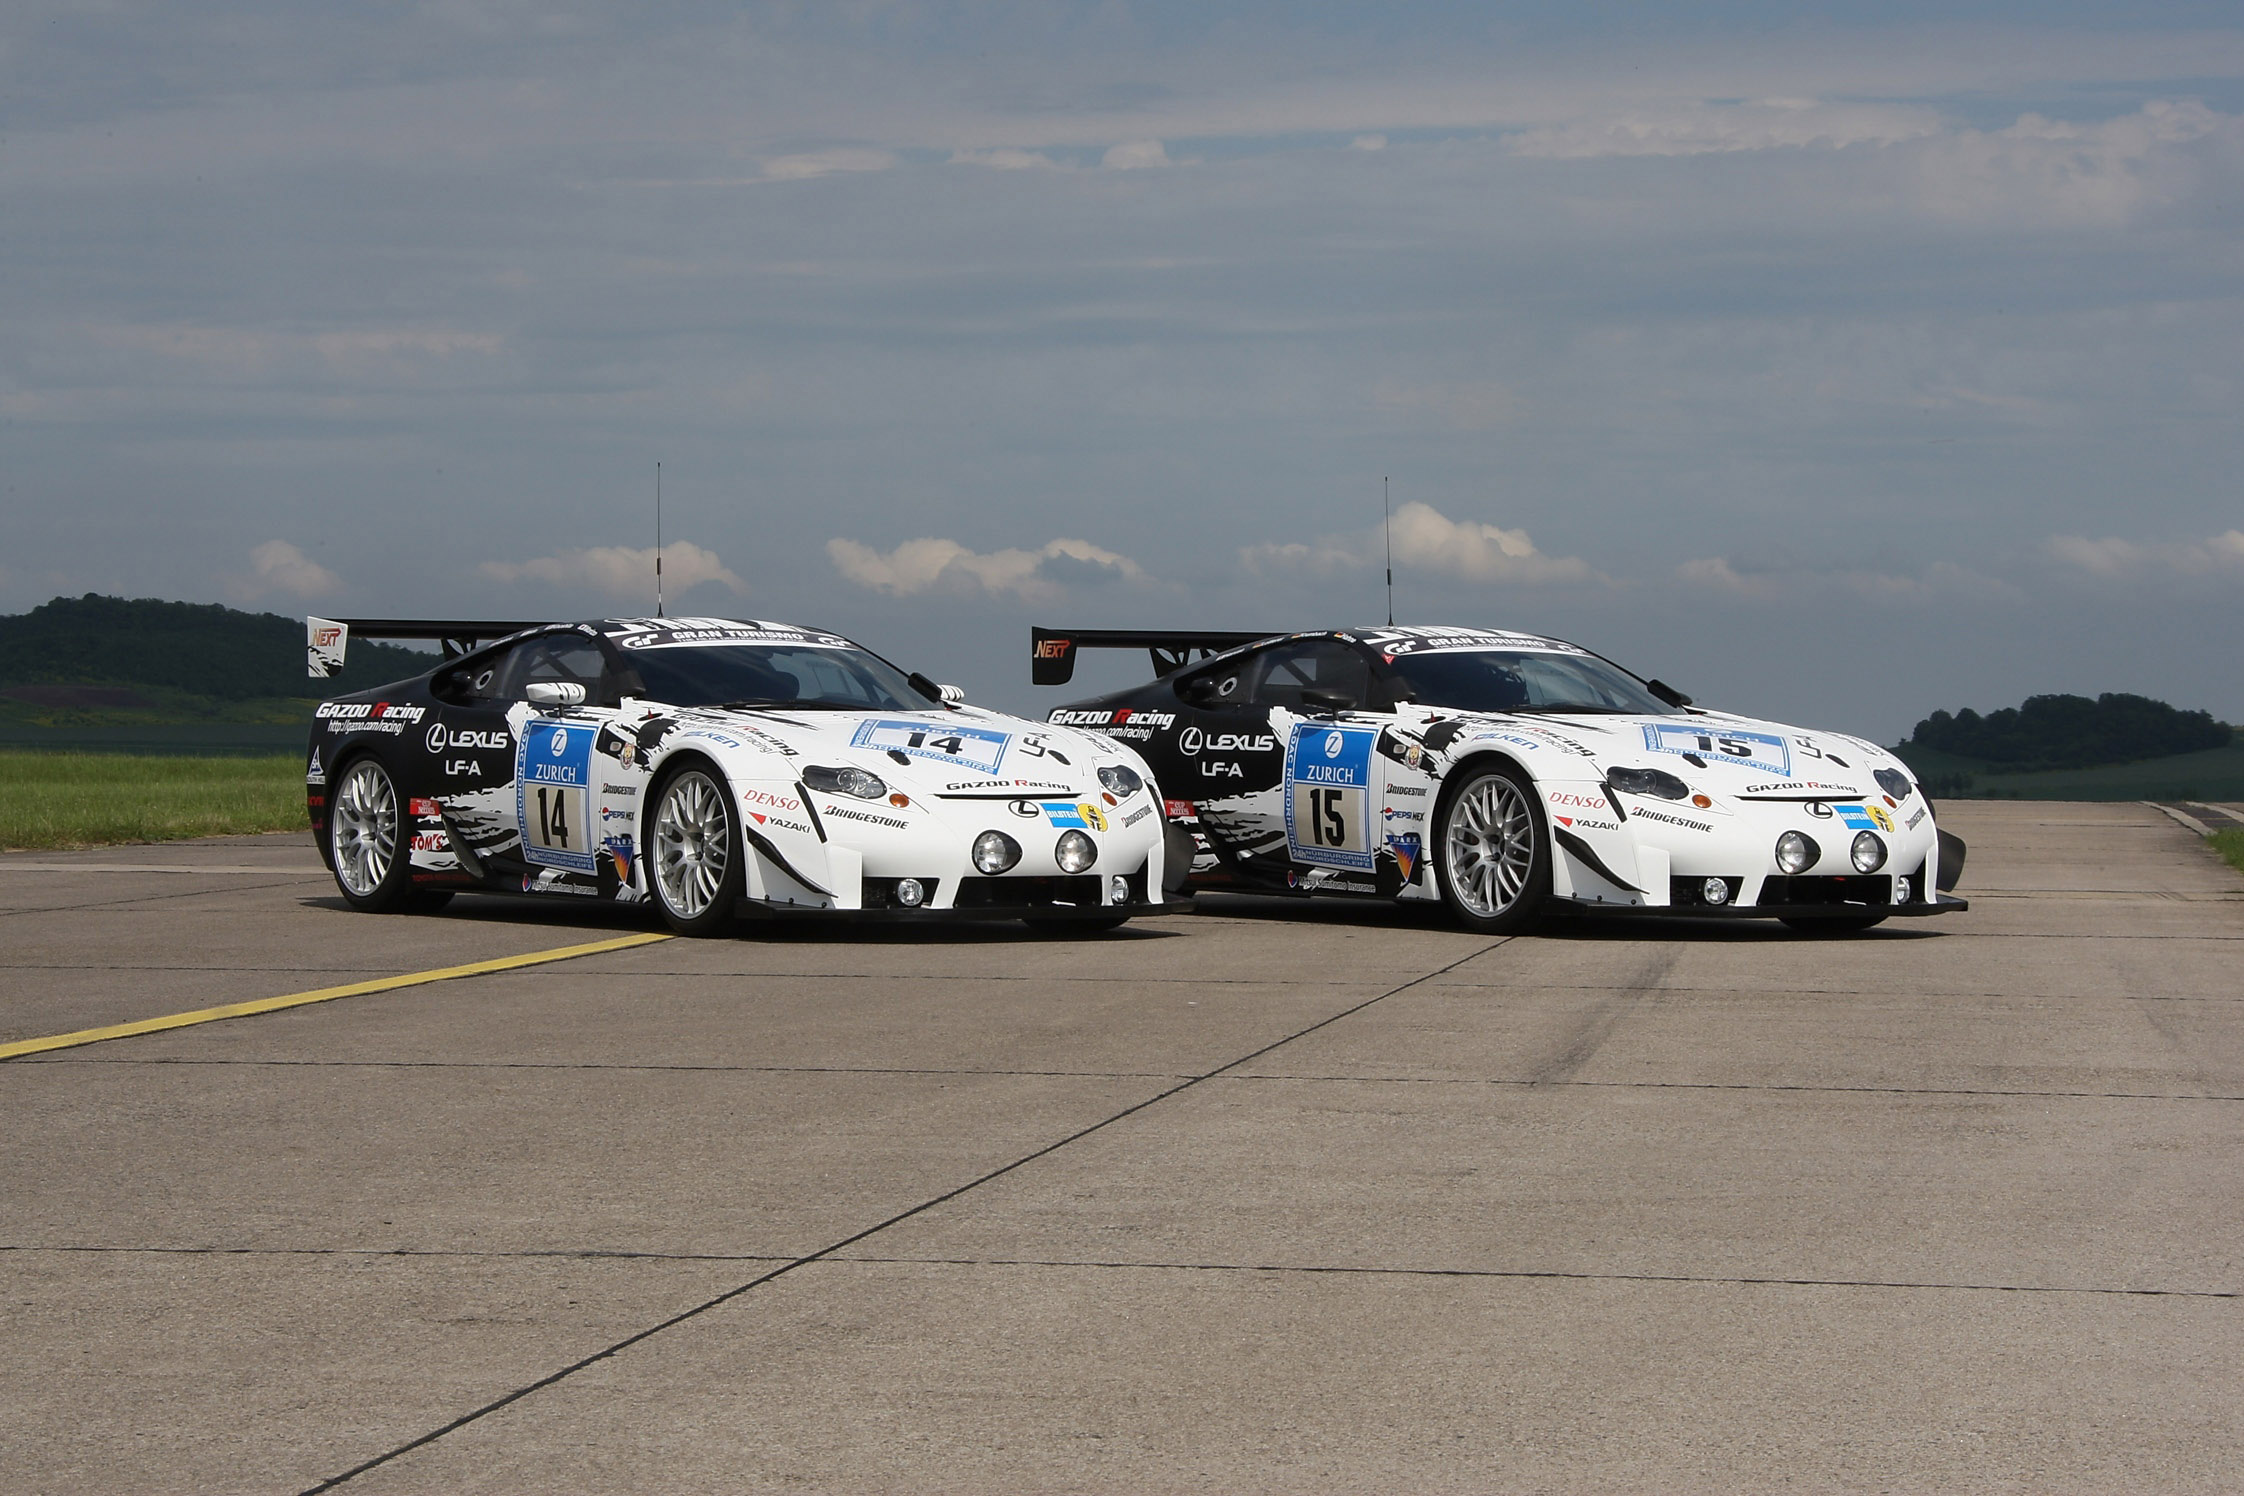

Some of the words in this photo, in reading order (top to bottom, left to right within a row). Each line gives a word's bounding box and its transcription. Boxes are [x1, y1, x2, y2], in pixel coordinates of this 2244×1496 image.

[313, 627, 341, 647] NEXT
[671, 630, 720, 639] GRAN
[725, 630, 805, 640] TURISMO
[1427, 637, 1474, 646] GRAN
[1475, 637, 1546, 648] TURISMO
[1034, 640, 1071, 658] NEXT
[316, 702, 372, 718] GAZOO
[370, 702, 426, 724] Racing
[1048, 709, 1113, 725] GAZOO
[1112, 708, 1177, 731] Racing
[449, 730, 508, 749] LEXUS
[519, 723, 530, 761] ADAC
[909, 731, 963, 755] 14
[1206, 733, 1275, 751] LEXUS
[1287, 725, 1301, 763] ADAC
[1693, 735, 1752, 757] 15
[445, 759, 482, 776] LF-A
[535, 763, 576, 782] ZURICH
[1202, 761, 1244, 777] LF-A
[1306, 764, 1354, 783] ZURICH
[946, 780, 1010, 791] GAZOO
[1014, 779, 1071, 792] Racing
[1385, 783, 1427, 797] BRIDGESTONE
[1746, 782, 1804, 793] GAZOO
[1807, 781, 1858, 794] Racing
[517, 767, 530, 849] NORDRHEIN
[743, 788, 800, 811] DENSO
[1284, 768, 1297, 848] NORDRHEIN
[1549, 791, 1606, 809] DENSO
[537, 787, 568, 849] 14
[822, 804, 910, 830] BRIDGESTONE
[1047, 810, 1080, 819] BILSTEIN
[1309, 788, 1345, 847] 15
[1630, 806, 1714, 833] BRIDGESTONE
[769, 816, 811, 834] YAZAKI
[1575, 818, 1619, 831] YAZAKI
[410, 833, 443, 851] TOM'S
